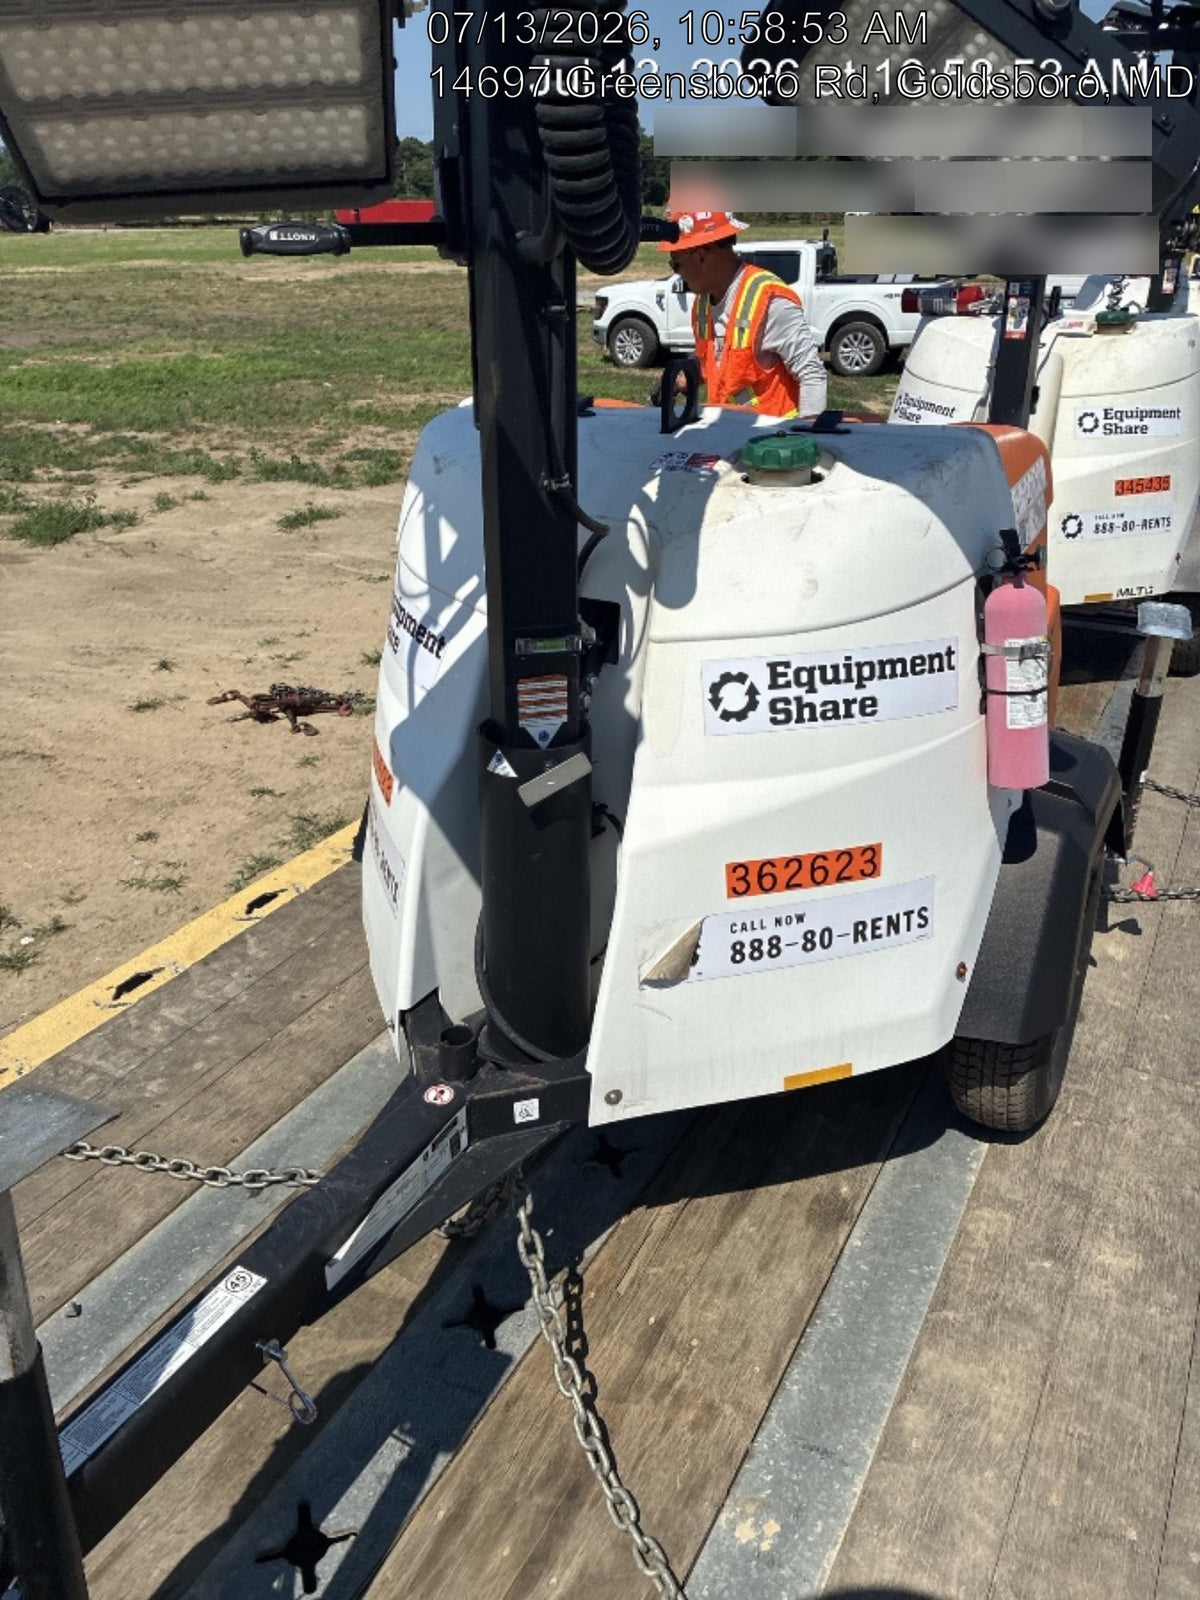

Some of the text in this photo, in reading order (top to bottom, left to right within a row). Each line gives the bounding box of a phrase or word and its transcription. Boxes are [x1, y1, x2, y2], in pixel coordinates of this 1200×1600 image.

[1102, 406, 1181, 422] Equipment
[1102, 422, 1148, 436] Share
[766, 645, 957, 694] Equipment
[767, 695, 879, 727] Share
[730, 846, 879, 897] 362623
[730, 913, 807, 934] CALL NOW
[730, 906, 930, 965] 888-80-RENTS
